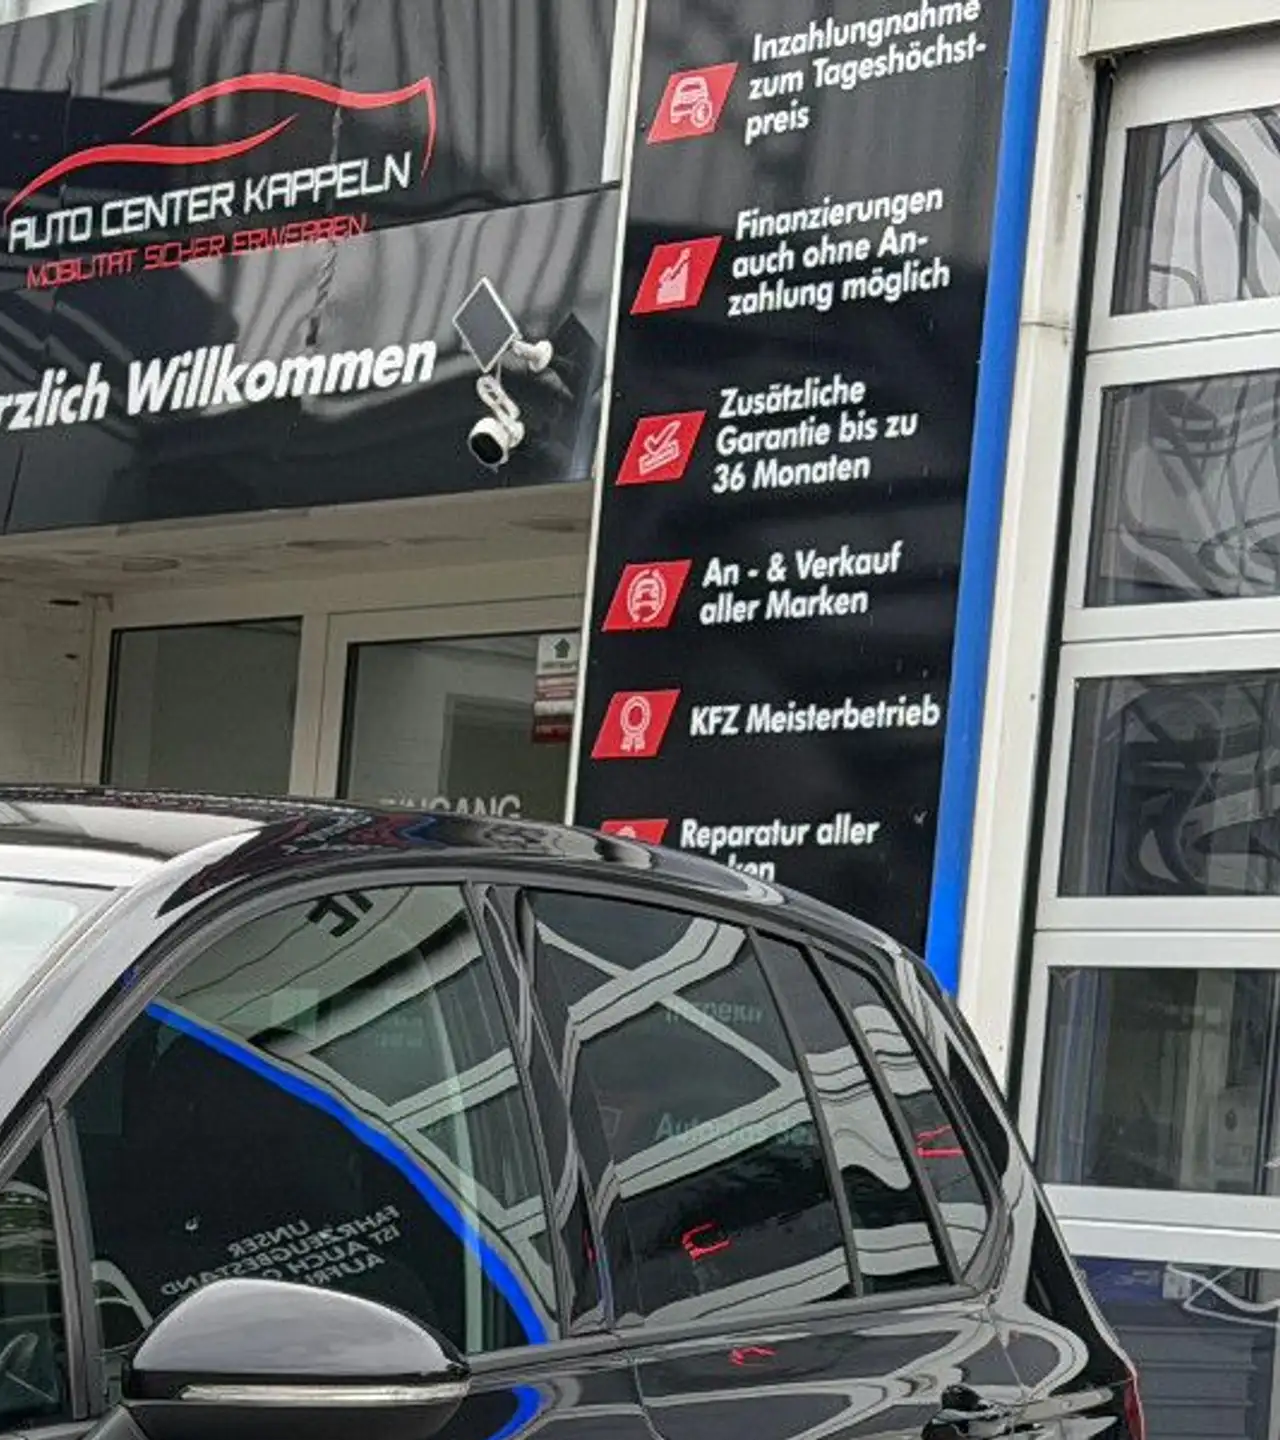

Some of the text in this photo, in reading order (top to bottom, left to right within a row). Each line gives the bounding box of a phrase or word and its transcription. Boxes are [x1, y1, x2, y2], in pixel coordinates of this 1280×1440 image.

[753, 0, 981, 61] Inzahlungnahme
[748, 35, 987, 101] zum Tageshöchst-
[744, 101, 810, 145] preis
[8, 151, 412, 253] AUTO CENTER KAPPELN
[735, 187, 944, 241] Finanzierungen
[232, 213, 369, 256] ERWERBEN
[732, 225, 930, 279] auch ohne An-
[726, 257, 951, 317] zahlung möglich
[126, 338, 437, 415] Willkommen
[719, 375, 866, 419] Zusätzliche
[715, 412, 919, 455] Garantie bis zu
[711, 454, 871, 495] 36 Monaten
[700, 554, 740, 587] An
[766, 552, 788, 583] &
[795, 541, 905, 579] Verkauf
[699, 587, 869, 625] aller Marken
[690, 695, 940, 736] KFZ Meisterbetrieb
[680, 813, 880, 855] Reparatur aller
